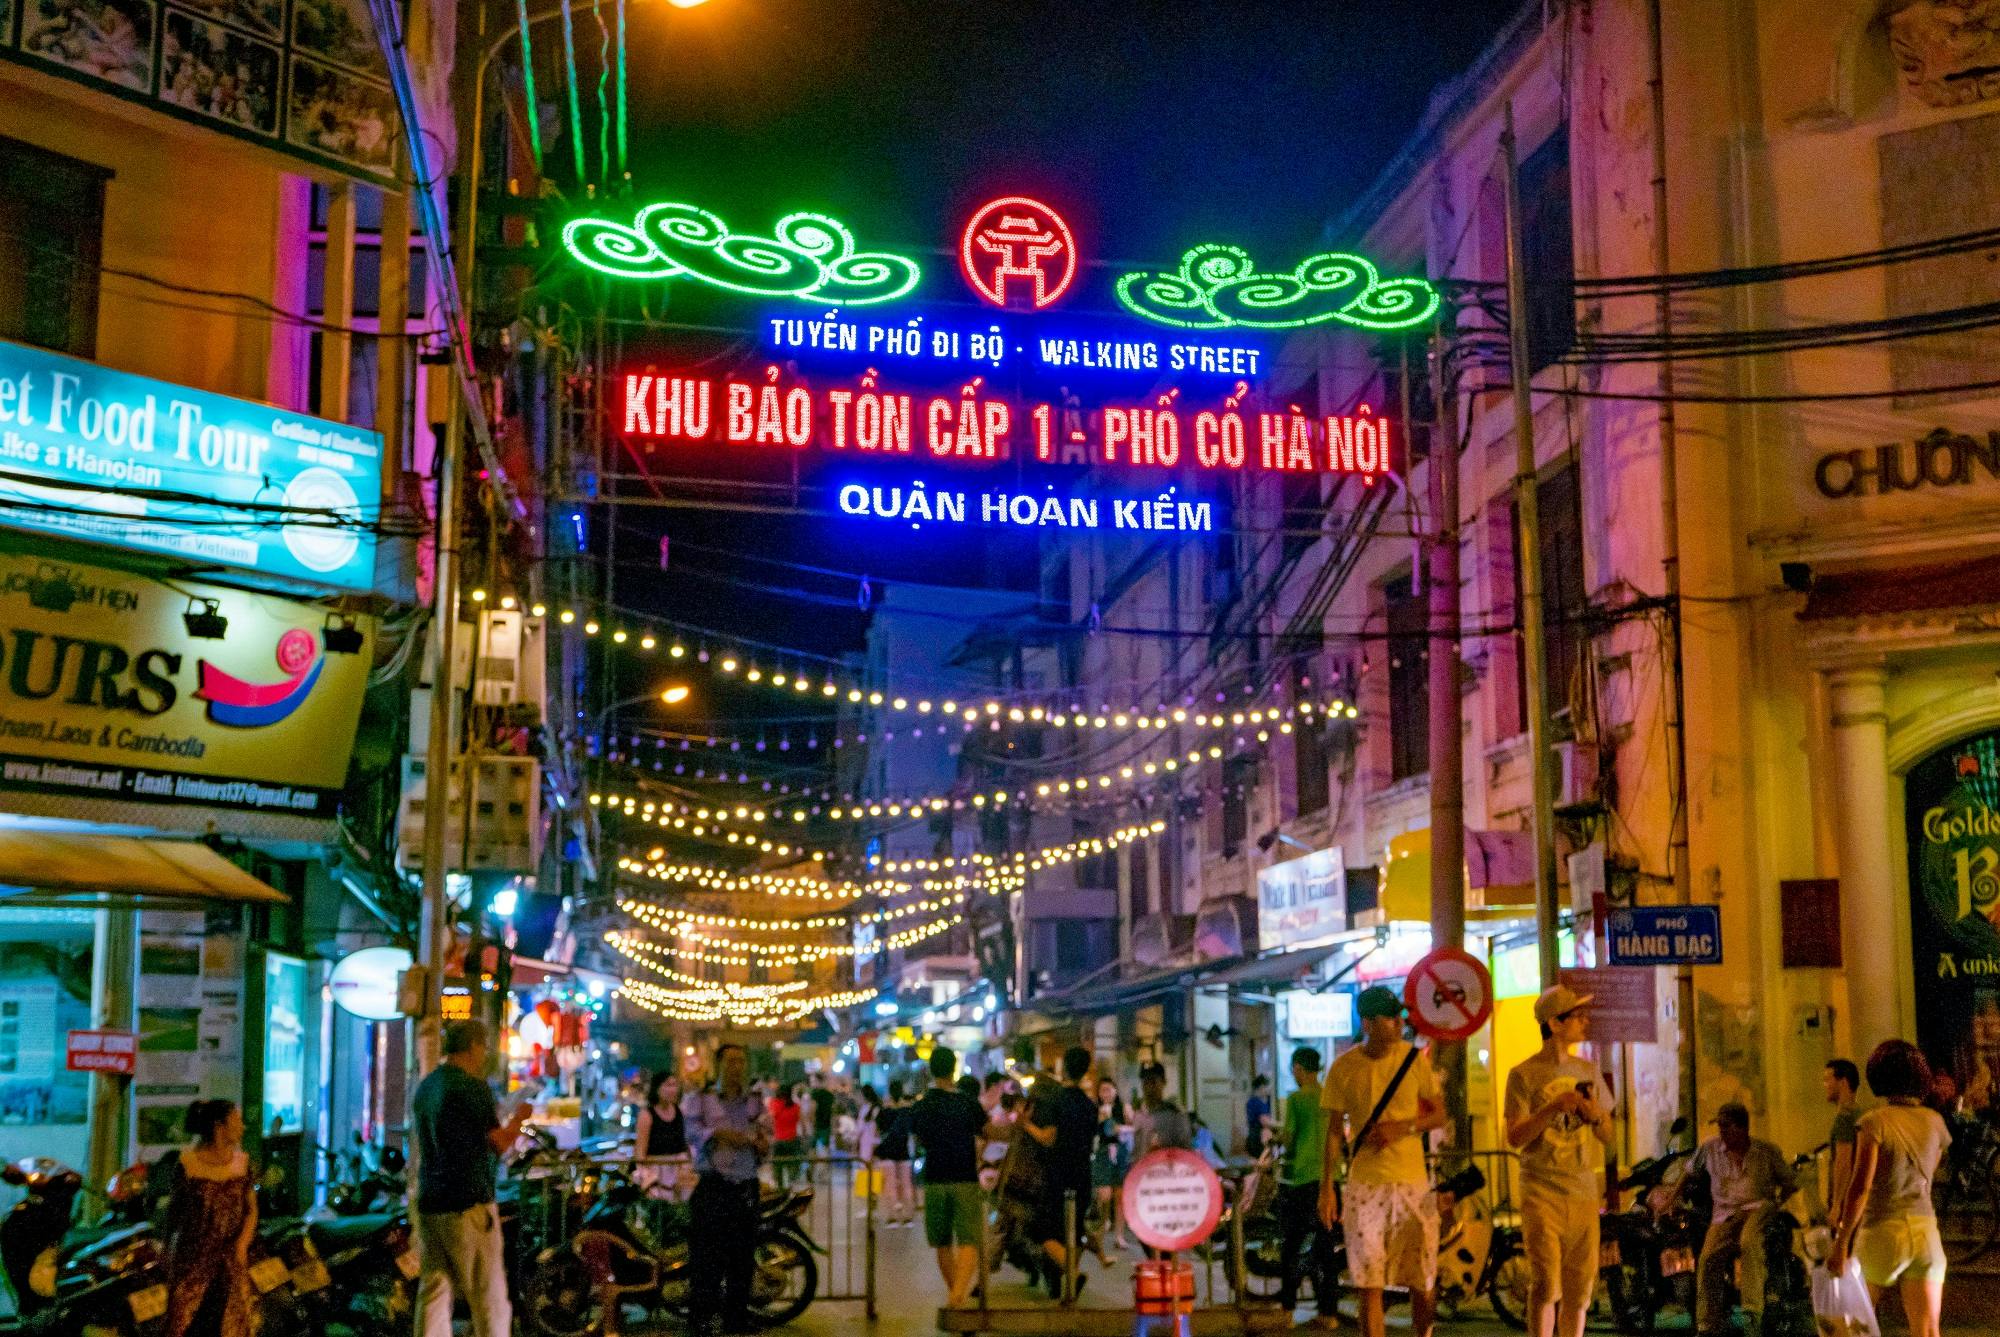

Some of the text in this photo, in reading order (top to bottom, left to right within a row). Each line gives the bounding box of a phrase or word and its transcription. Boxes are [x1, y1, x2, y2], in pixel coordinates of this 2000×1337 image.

[869, 317, 923, 356] PHỐ
[932, 330, 959, 358] ĐI
[970, 325, 1003, 367] BỘ
[1039, 338, 1158, 369] WALKING
[1170, 344, 1260, 375] STREET
[46, 372, 158, 453] Food
[169, 400, 270, 475] Tour
[624, 374, 711, 438] KHU
[728, 365, 811, 446] BẢO
[829, 367, 911, 452] TỒN
[927, 377, 1010, 457] CẤP
[1032, 404, 1050, 459] 1
[1104, 387, 1180, 465] PHỐ
[1195, 380, 1248, 467] CỔ
[1260, 403, 1313, 471] HÀ
[1327, 403, 1390, 486] NỘI
[44, 447, 60, 467] a
[66, 444, 162, 488] Hanoian
[839, 481, 965, 529] QUẬN
[0, 627, 182, 717] URS
[117, 728, 206, 759] Cambodia
[1617, 930, 1713, 960] HÀNG BẠC
